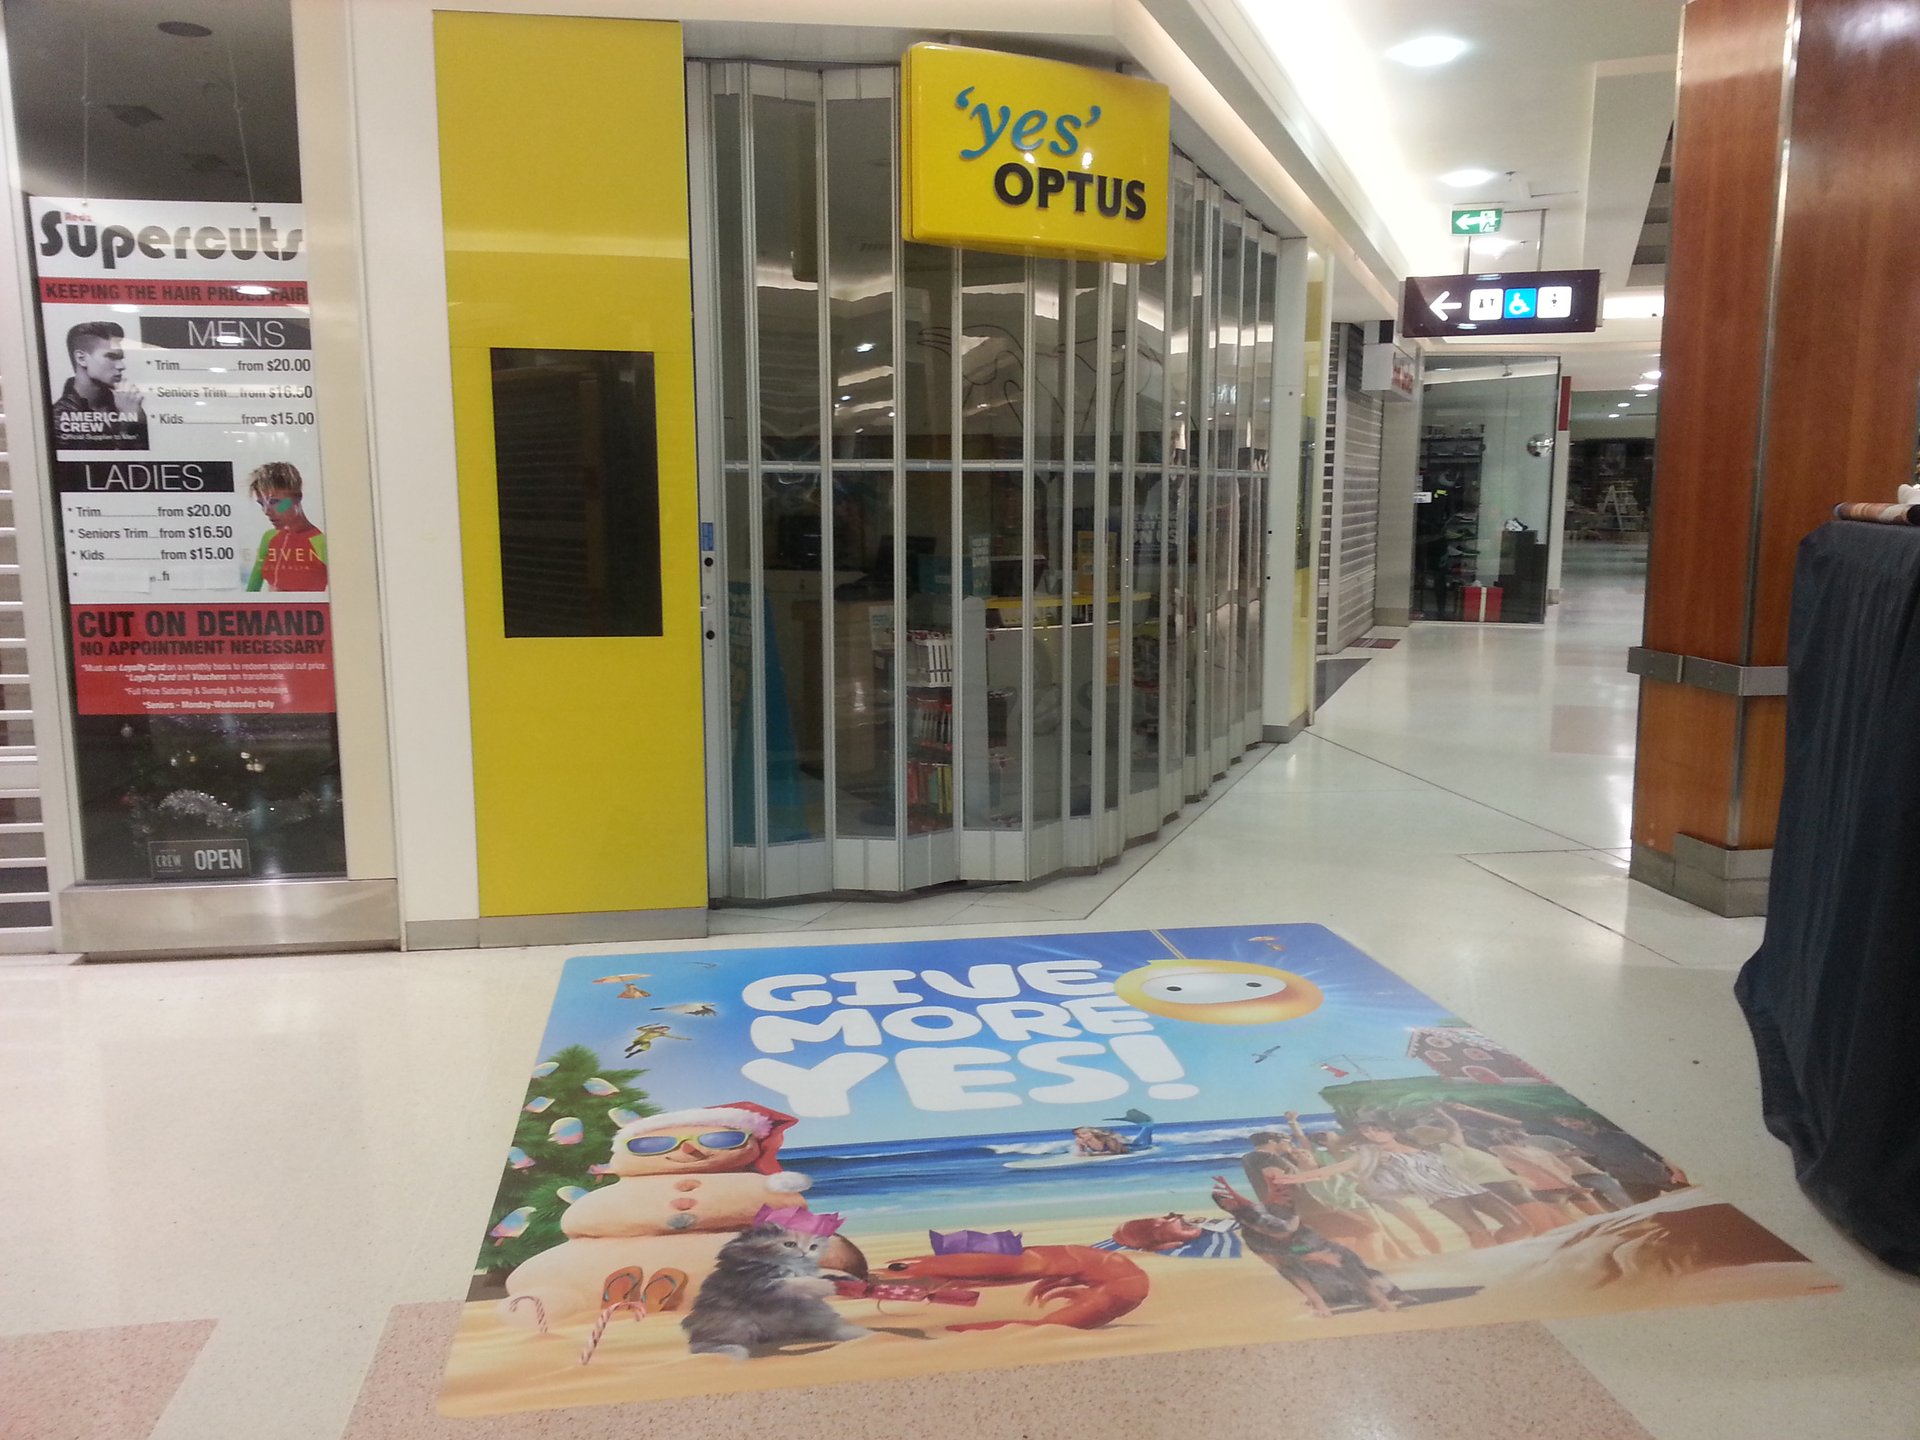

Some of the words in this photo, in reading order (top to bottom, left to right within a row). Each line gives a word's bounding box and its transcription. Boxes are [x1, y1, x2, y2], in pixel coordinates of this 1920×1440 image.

[994, 162, 1147, 221] OPTUS
[40, 210, 303, 269] Supercuts
[46, 283, 119, 299] KEEPING
[124, 285, 156, 300] THE
[162, 286, 201, 301] HAIR
[208, 286, 267, 302] PRI
[271, 287, 308, 302] FAIR
[188, 320, 286, 348] MENS
[155, 360, 180, 371] Trim
[238, 361, 264, 372] from
[267, 358, 312, 372] $20.00
[157, 386, 199, 398] Seniors
[203, 386, 227, 398] Trim
[240, 387, 266, 398] from
[269, 385, 313, 399] $16.50
[60, 412, 138, 428] AMERICAN
[60, 422, 104, 432] CREW
[159, 413, 184, 424] Kids
[241, 414, 268, 425] from
[270, 412, 314, 425] $15.00
[85, 464, 204, 491] LADIES
[77, 506, 101, 517] Trim
[158, 507, 184, 517] from
[187, 504, 231, 517] $20.00
[78, 528, 120, 539] Seniors
[124, 528, 148, 538] Trim
[160, 528, 185, 539] from
[189, 526, 233, 539] $16.50
[80, 550, 104, 560] Kids
[161, 550, 187, 560] from
[190, 547, 234, 560] $15.00
[79, 611, 134, 637] CUT
[145, 611, 185, 636] ON
[197, 610, 324, 636] DEMAND
[80, 642, 103, 655] NO
[109, 640, 224, 656] APPOINTMENT
[231, 640, 325, 655] NECESSARY
[156, 855, 181, 867] CREW
[194, 849, 243, 870] OPEN
[742, 960, 1115, 1012] GIVE
[750, 995, 1155, 1053] MORE
[741, 1035, 1200, 1118] YES!
